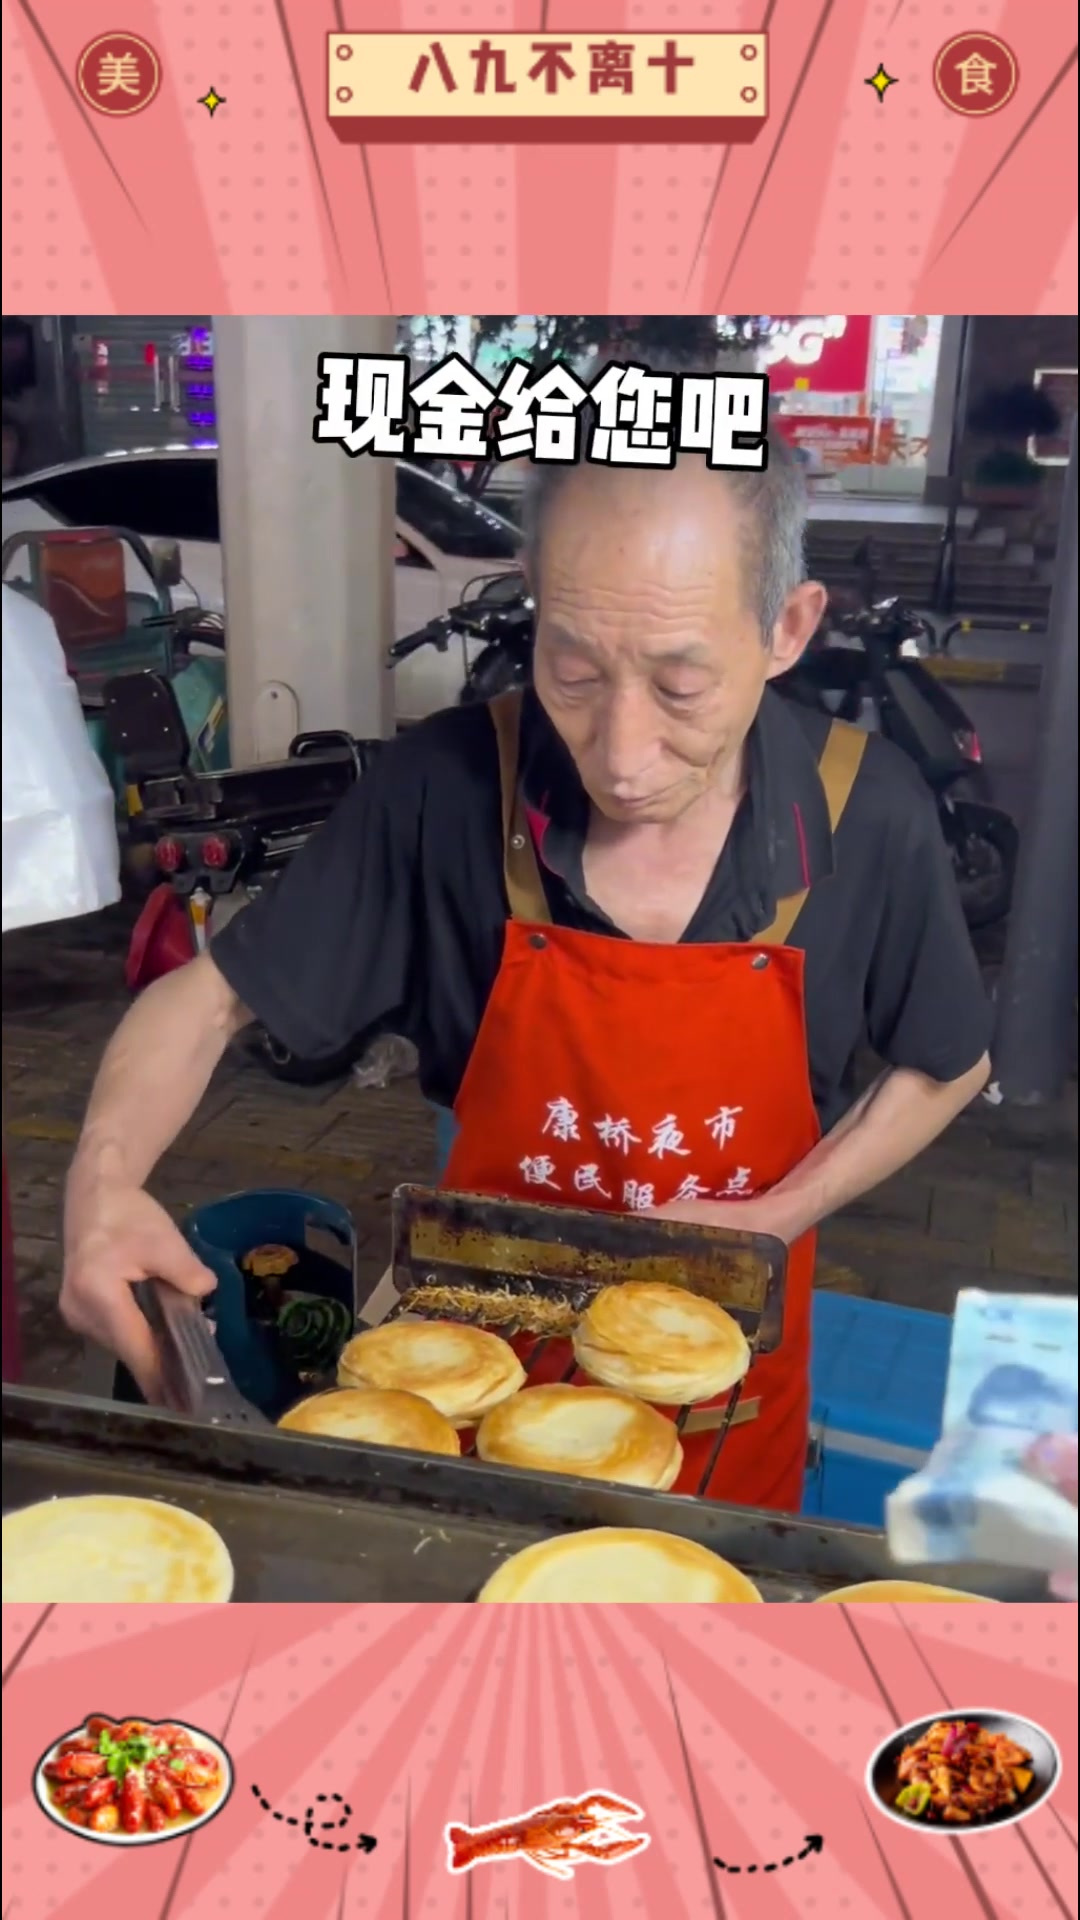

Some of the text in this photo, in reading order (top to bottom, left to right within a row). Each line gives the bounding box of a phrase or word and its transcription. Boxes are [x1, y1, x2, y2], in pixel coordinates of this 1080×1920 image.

[541, 1095, 744, 1159] 康桥夜市
[518, 1153, 753, 1212] 便民服务点
